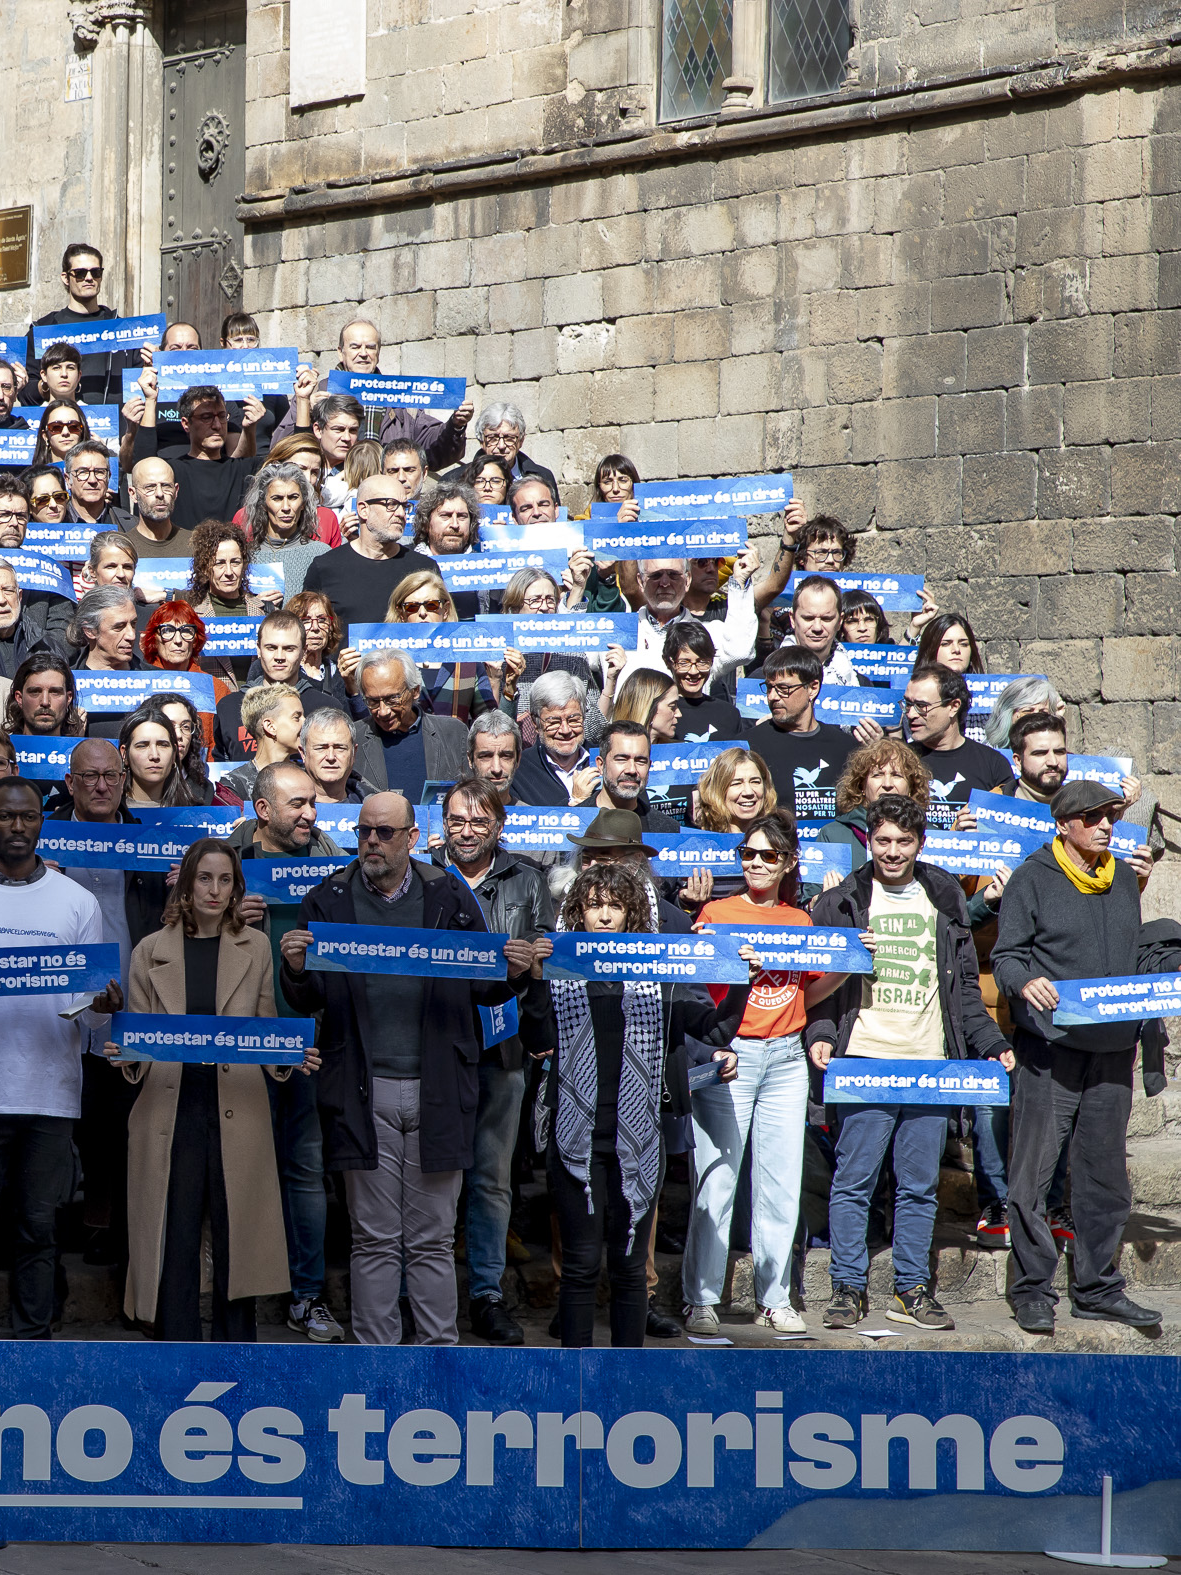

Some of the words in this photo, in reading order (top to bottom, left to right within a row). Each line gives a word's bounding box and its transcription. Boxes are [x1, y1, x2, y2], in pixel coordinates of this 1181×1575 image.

[101, 329, 116, 339] és
[117, 328, 132, 338] un
[134, 324, 159, 338] dret
[160, 362, 226, 376] protestar
[226, 362, 242, 372] és
[244, 362, 260, 372] un
[262, 359, 290, 372] dret
[350, 378, 412, 391] protestar
[413, 381, 428, 391] no
[430, 379, 445, 392] és
[361, 391, 430, 404] terrorisme
[644, 495, 712, 509] protestar
[714, 493, 729, 504] és
[733, 493, 752, 503] un
[754, 487, 784, 501] dret
[592, 536, 665, 549] protestar
[667, 534, 684, 546] és
[686, 535, 704, 545] un
[707, 531, 740, 544] dret
[433, 636, 450, 649] és
[452, 639, 471, 648] un
[474, 636, 506, 648] dret
[518, 634, 600, 647] terrorisme
[76, 678, 150, 692] protestar
[152, 679, 170, 688] no
[173, 677, 190, 689] és
[863, 702, 895, 715] dret
[975, 807, 1055, 831] protestar
[702, 848, 735, 860] dret
[879, 918, 903, 933] FIN
[907, 919, 917, 928] AL
[317, 941, 406, 960] protestar
[408, 944, 429, 958] és
[431, 948, 455, 961] un
[458, 947, 497, 963] dret
[576, 940, 666, 957] protestar
[668, 943, 690, 955] no
[693, 940, 715, 955] és
[40, 955, 63, 967] no
[66, 950, 86, 966] és
[594, 959, 696, 975] terrorisme
[880, 968, 910, 980] ARMAS
[1080, 981, 1152, 1002] protestar
[1153, 980, 1171, 992] no
[1098, 998, 1180, 1016] terrorisme
[123, 1031, 211, 1048] protestar
[214, 1032, 235, 1046] és
[238, 1035, 261, 1047] un
[263, 1033, 304, 1048] dret
[835, 1073, 915, 1089] protestar
[917, 1073, 937, 1088] és
[939, 1077, 961, 1088] un
[964, 1074, 999, 1090] dret
[159, 1382, 306, 1484] és
[328, 1391, 1064, 1492] terrorisme
